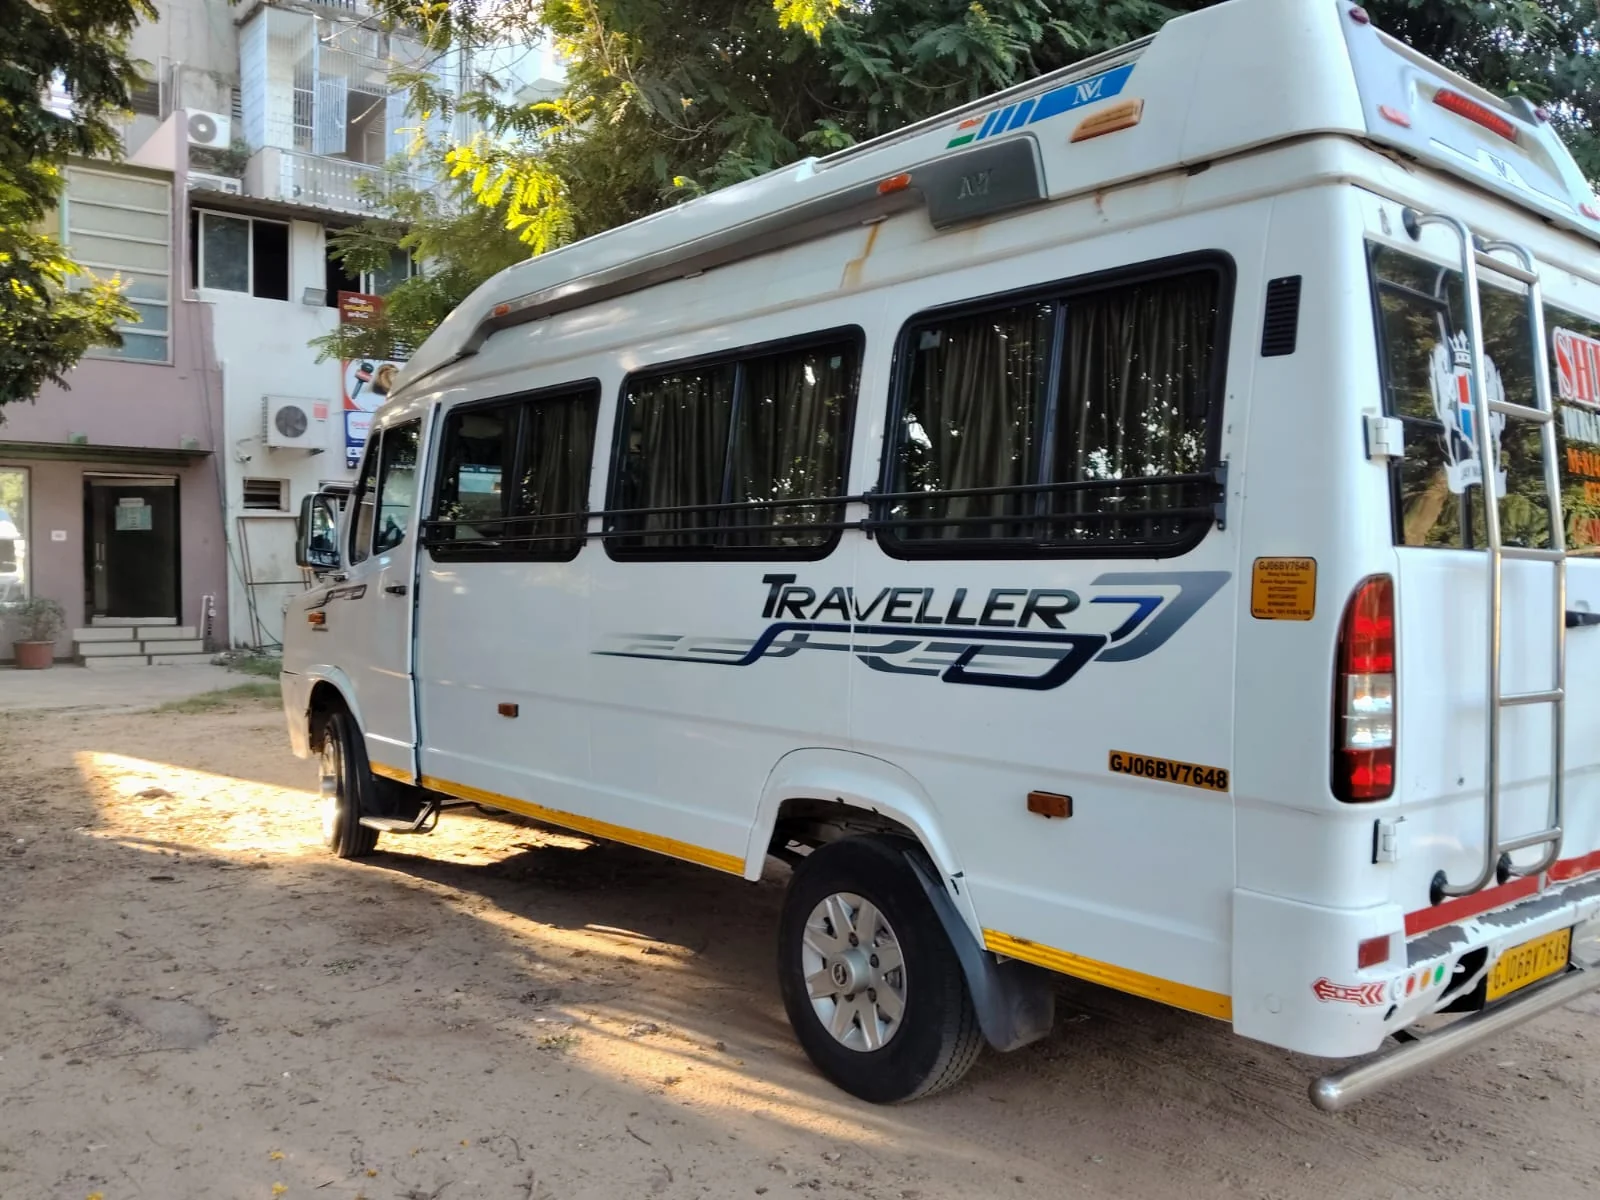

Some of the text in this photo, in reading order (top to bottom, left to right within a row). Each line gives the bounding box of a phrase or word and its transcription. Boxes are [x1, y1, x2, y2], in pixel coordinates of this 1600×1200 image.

[761, 573, 1081, 629] TRAVELLER
[1110, 754, 1228, 789] GJ06BV7648
[1494, 934, 1568, 990] GJ06BV7648
